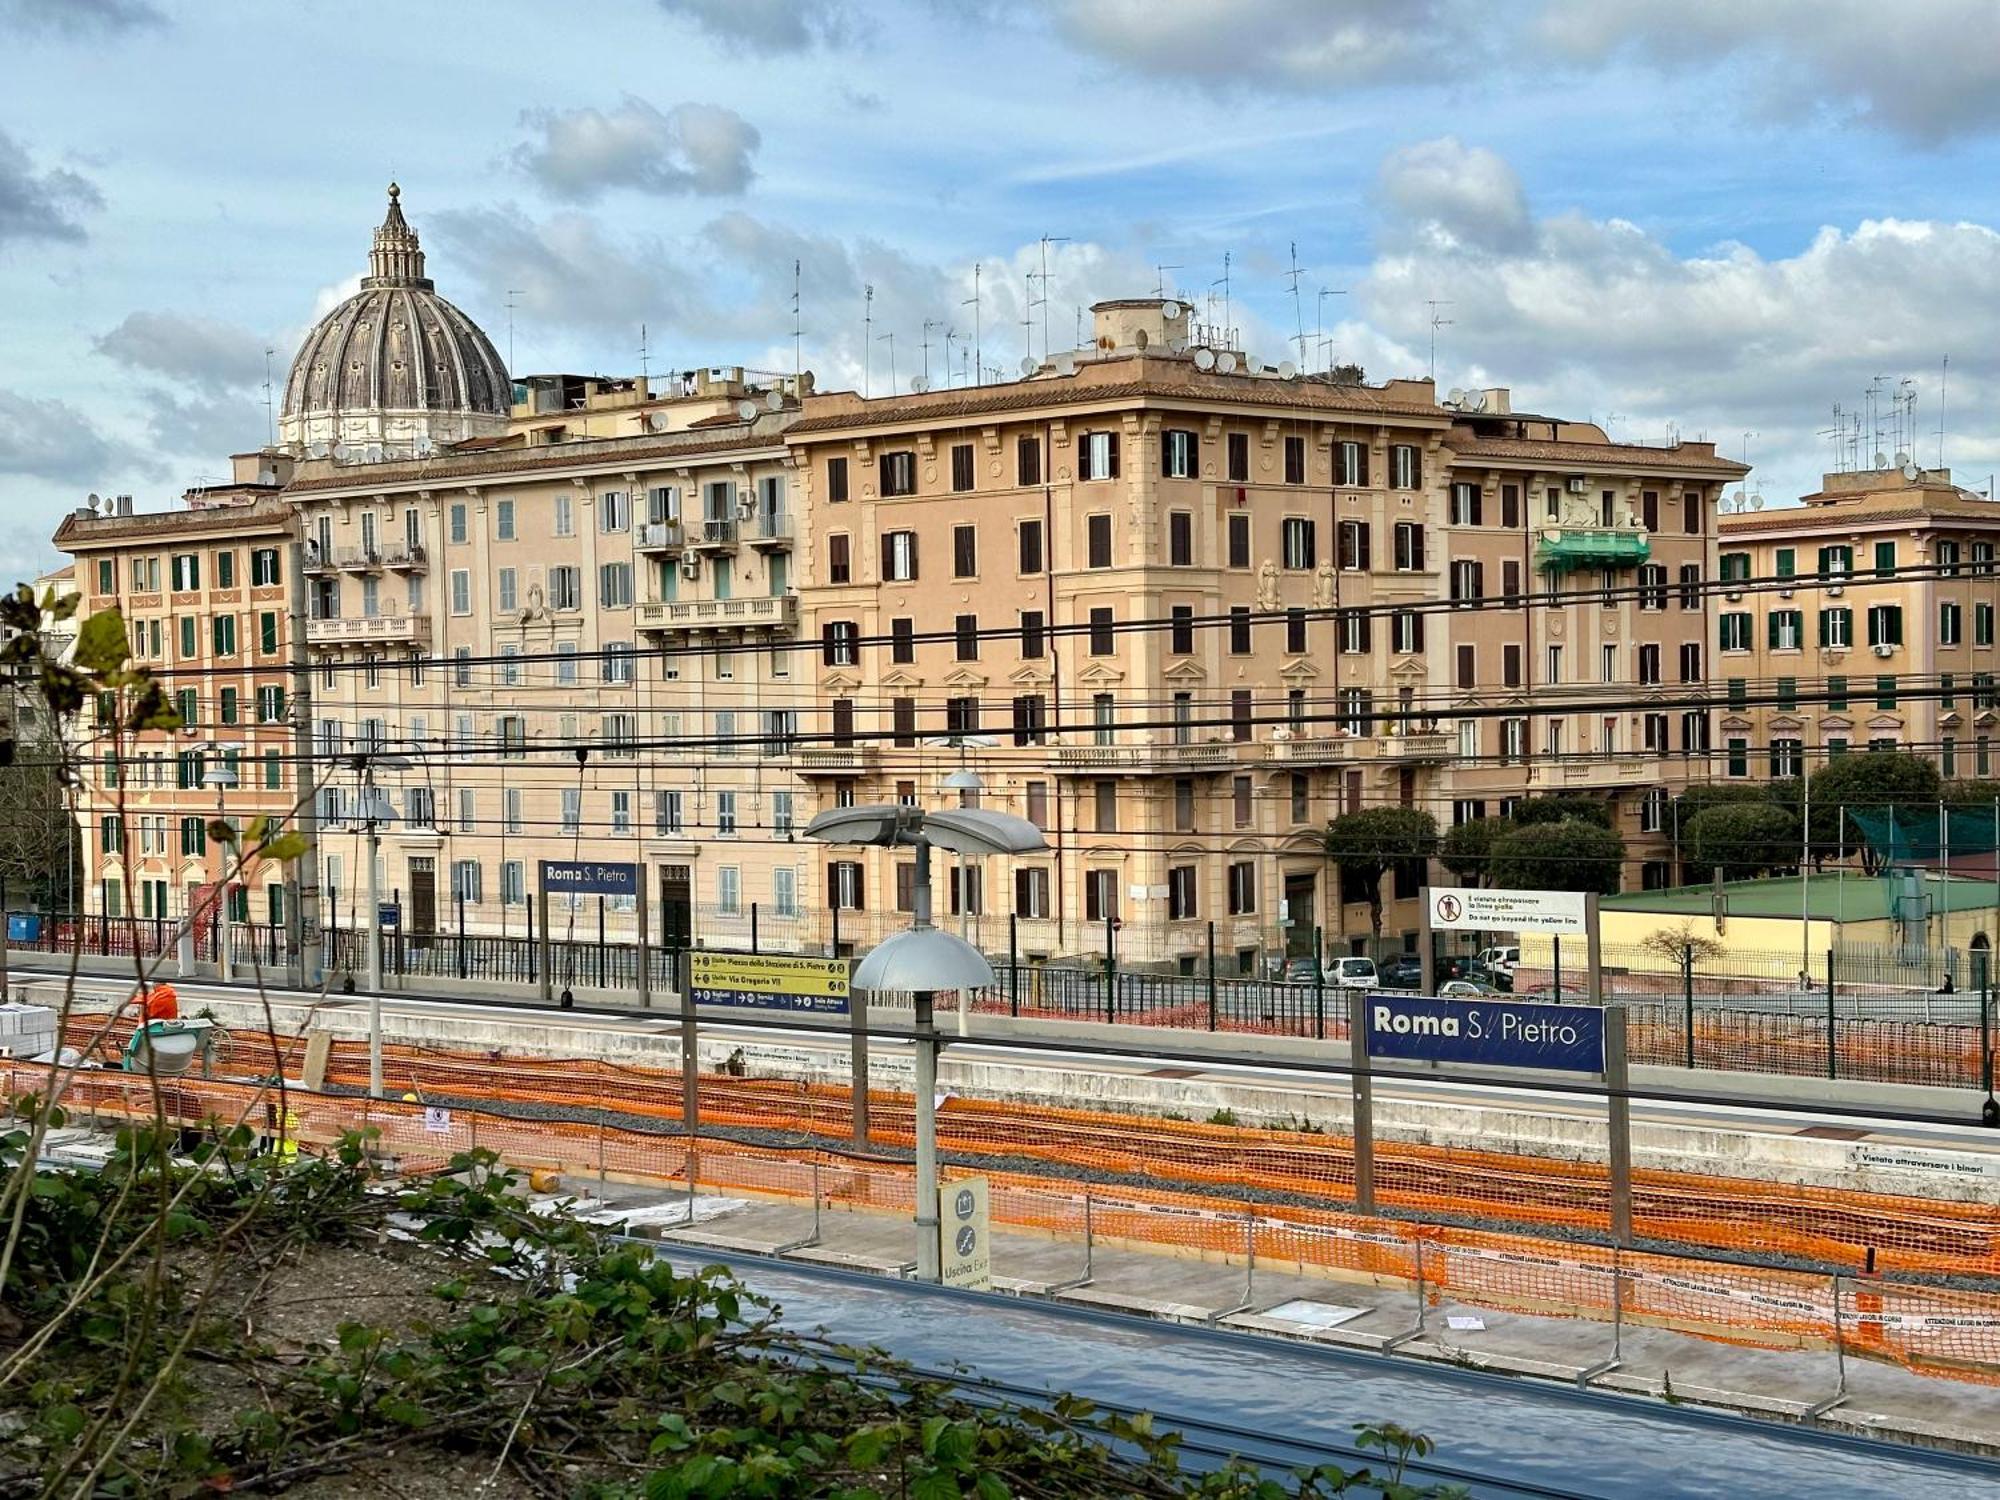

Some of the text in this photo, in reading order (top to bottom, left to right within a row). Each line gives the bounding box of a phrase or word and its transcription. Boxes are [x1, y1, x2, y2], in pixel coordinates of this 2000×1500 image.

[547, 866, 582, 880] Roma
[597, 867, 627, 882] Pietro
[1541, 917, 1563, 925] yellow
[1565, 917, 1578, 925] line
[728, 958, 749, 966] Piazza
[749, 959, 764, 967] della
[765, 960, 792, 969] Stazione
[793, 960, 799, 968] di
[807, 962, 826, 970] Pietro
[729, 975, 740, 983] Via
[741, 976, 770, 986] Gregorio
[1374, 1006, 1577, 1045] Roma S. Pietro
[1862, 1154, 1893, 1164] Vietato
[1895, 1157, 1950, 1170] attraversare
[1956, 1163, 1983, 1173] binari
[945, 1262, 972, 1279] Uscita
